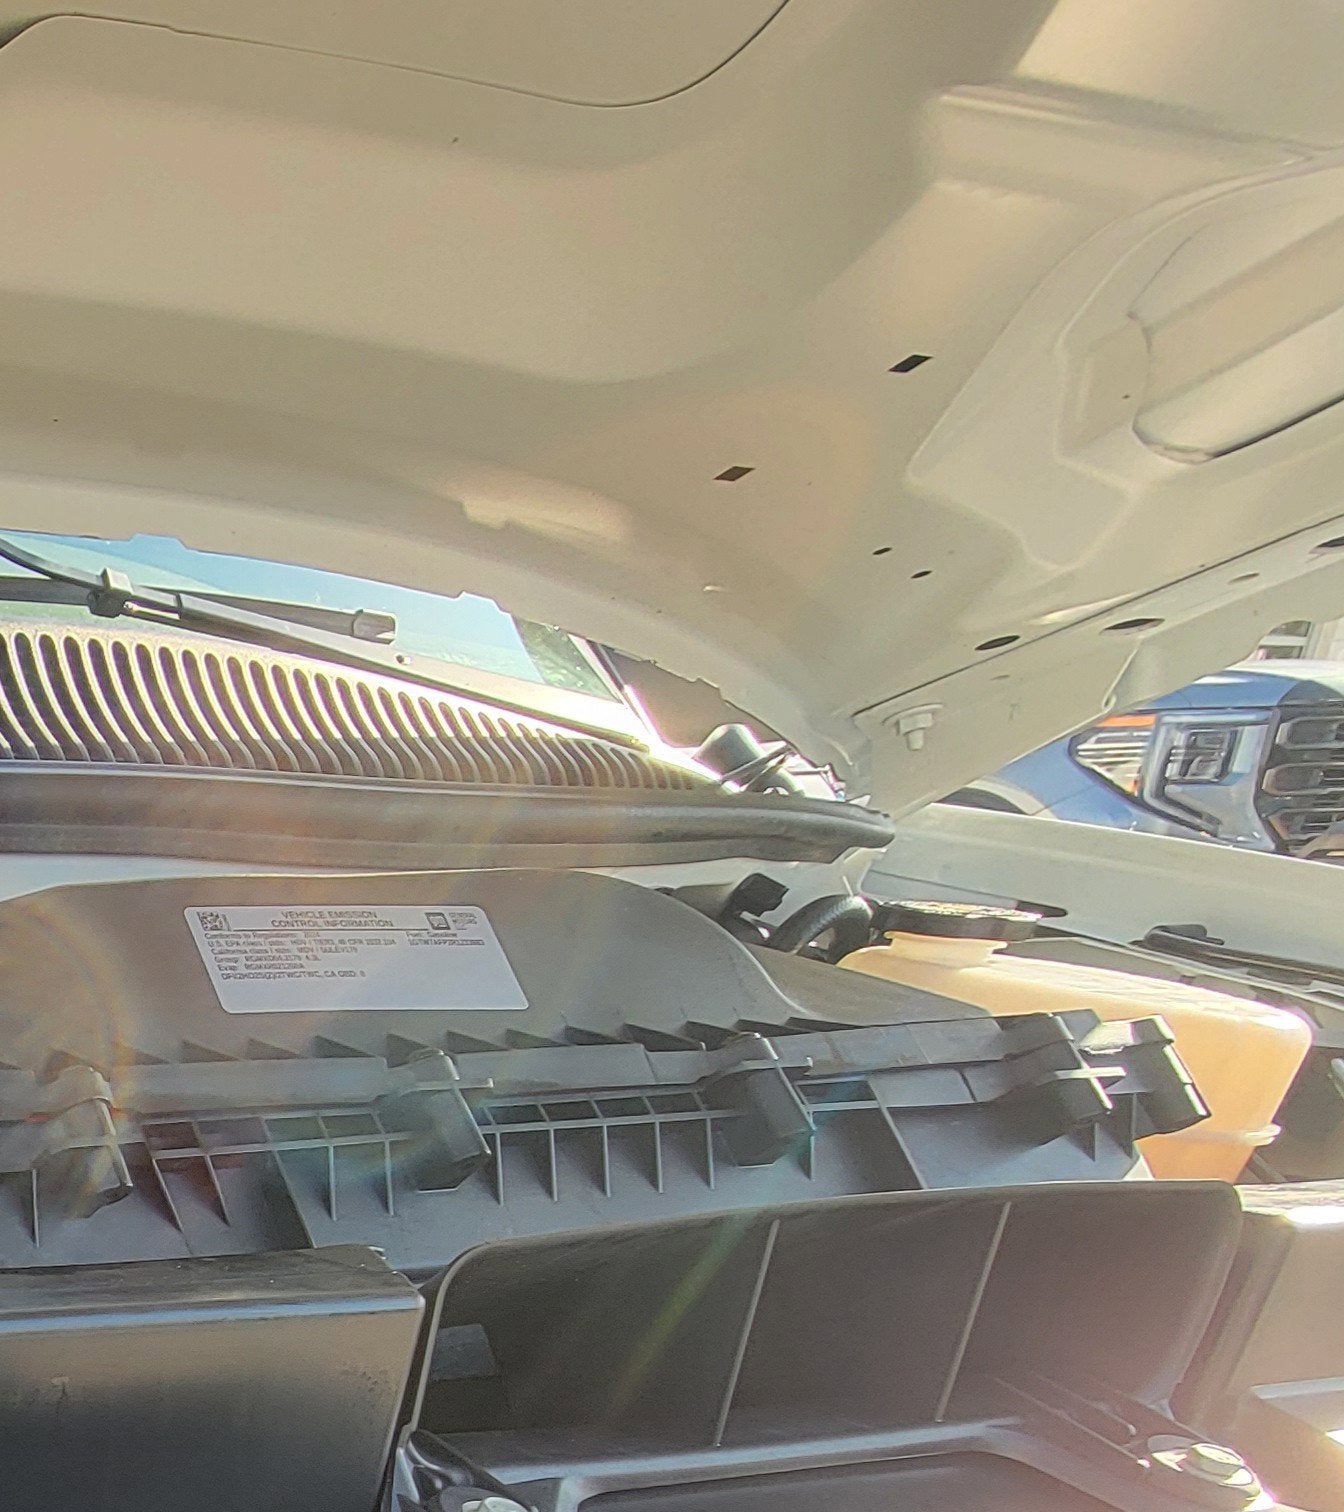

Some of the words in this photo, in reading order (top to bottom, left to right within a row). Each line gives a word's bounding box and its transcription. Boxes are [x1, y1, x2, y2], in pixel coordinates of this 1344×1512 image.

[281, 910, 327, 919] VEHICLE
[328, 910, 378, 919] EMISSION
[271, 919, 321, 928] CONTROL
[324, 919, 394, 928] INFORMATION
